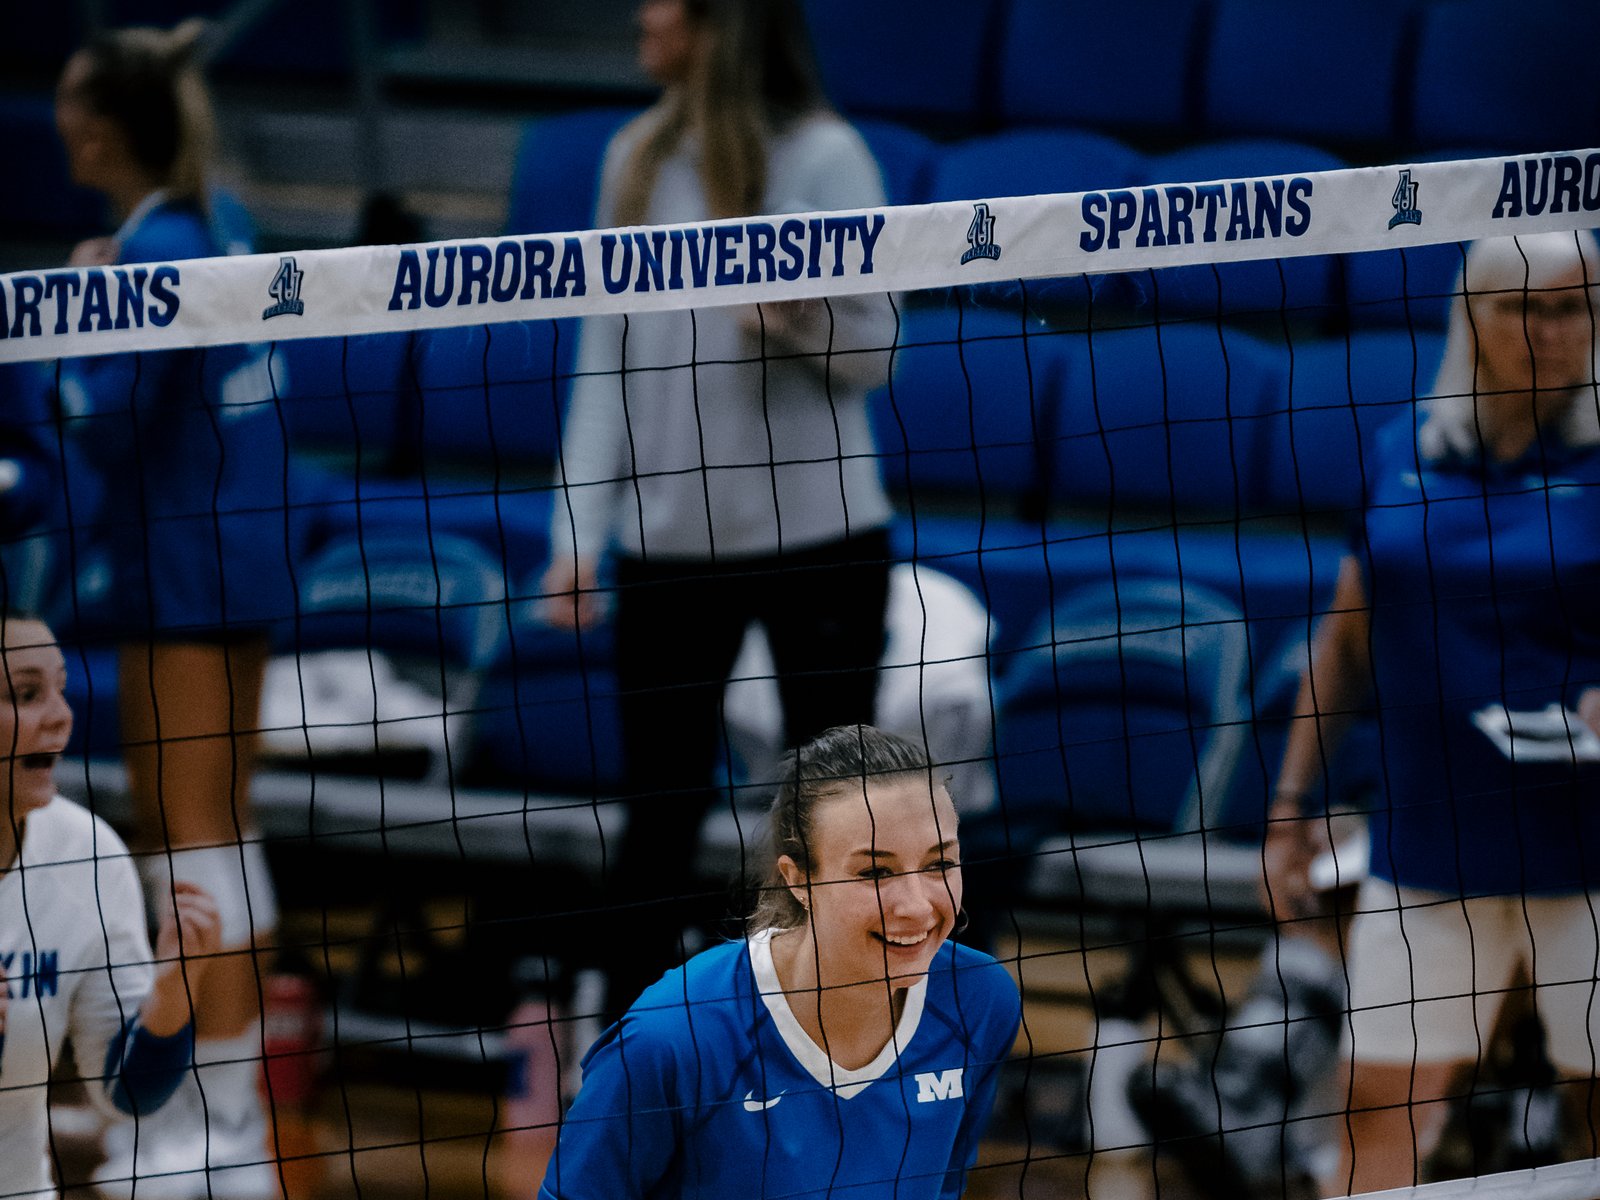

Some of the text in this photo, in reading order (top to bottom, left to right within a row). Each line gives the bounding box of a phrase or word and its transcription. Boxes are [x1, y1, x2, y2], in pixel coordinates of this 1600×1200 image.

[1079, 176, 1313, 252] SPARTANS
[1491, 153, 1600, 219] AURO
[387, 213, 886, 312] AURORA UNIVERSITY
[0, 265, 180, 339] RTANS
[914, 1067, 964, 1104] M
